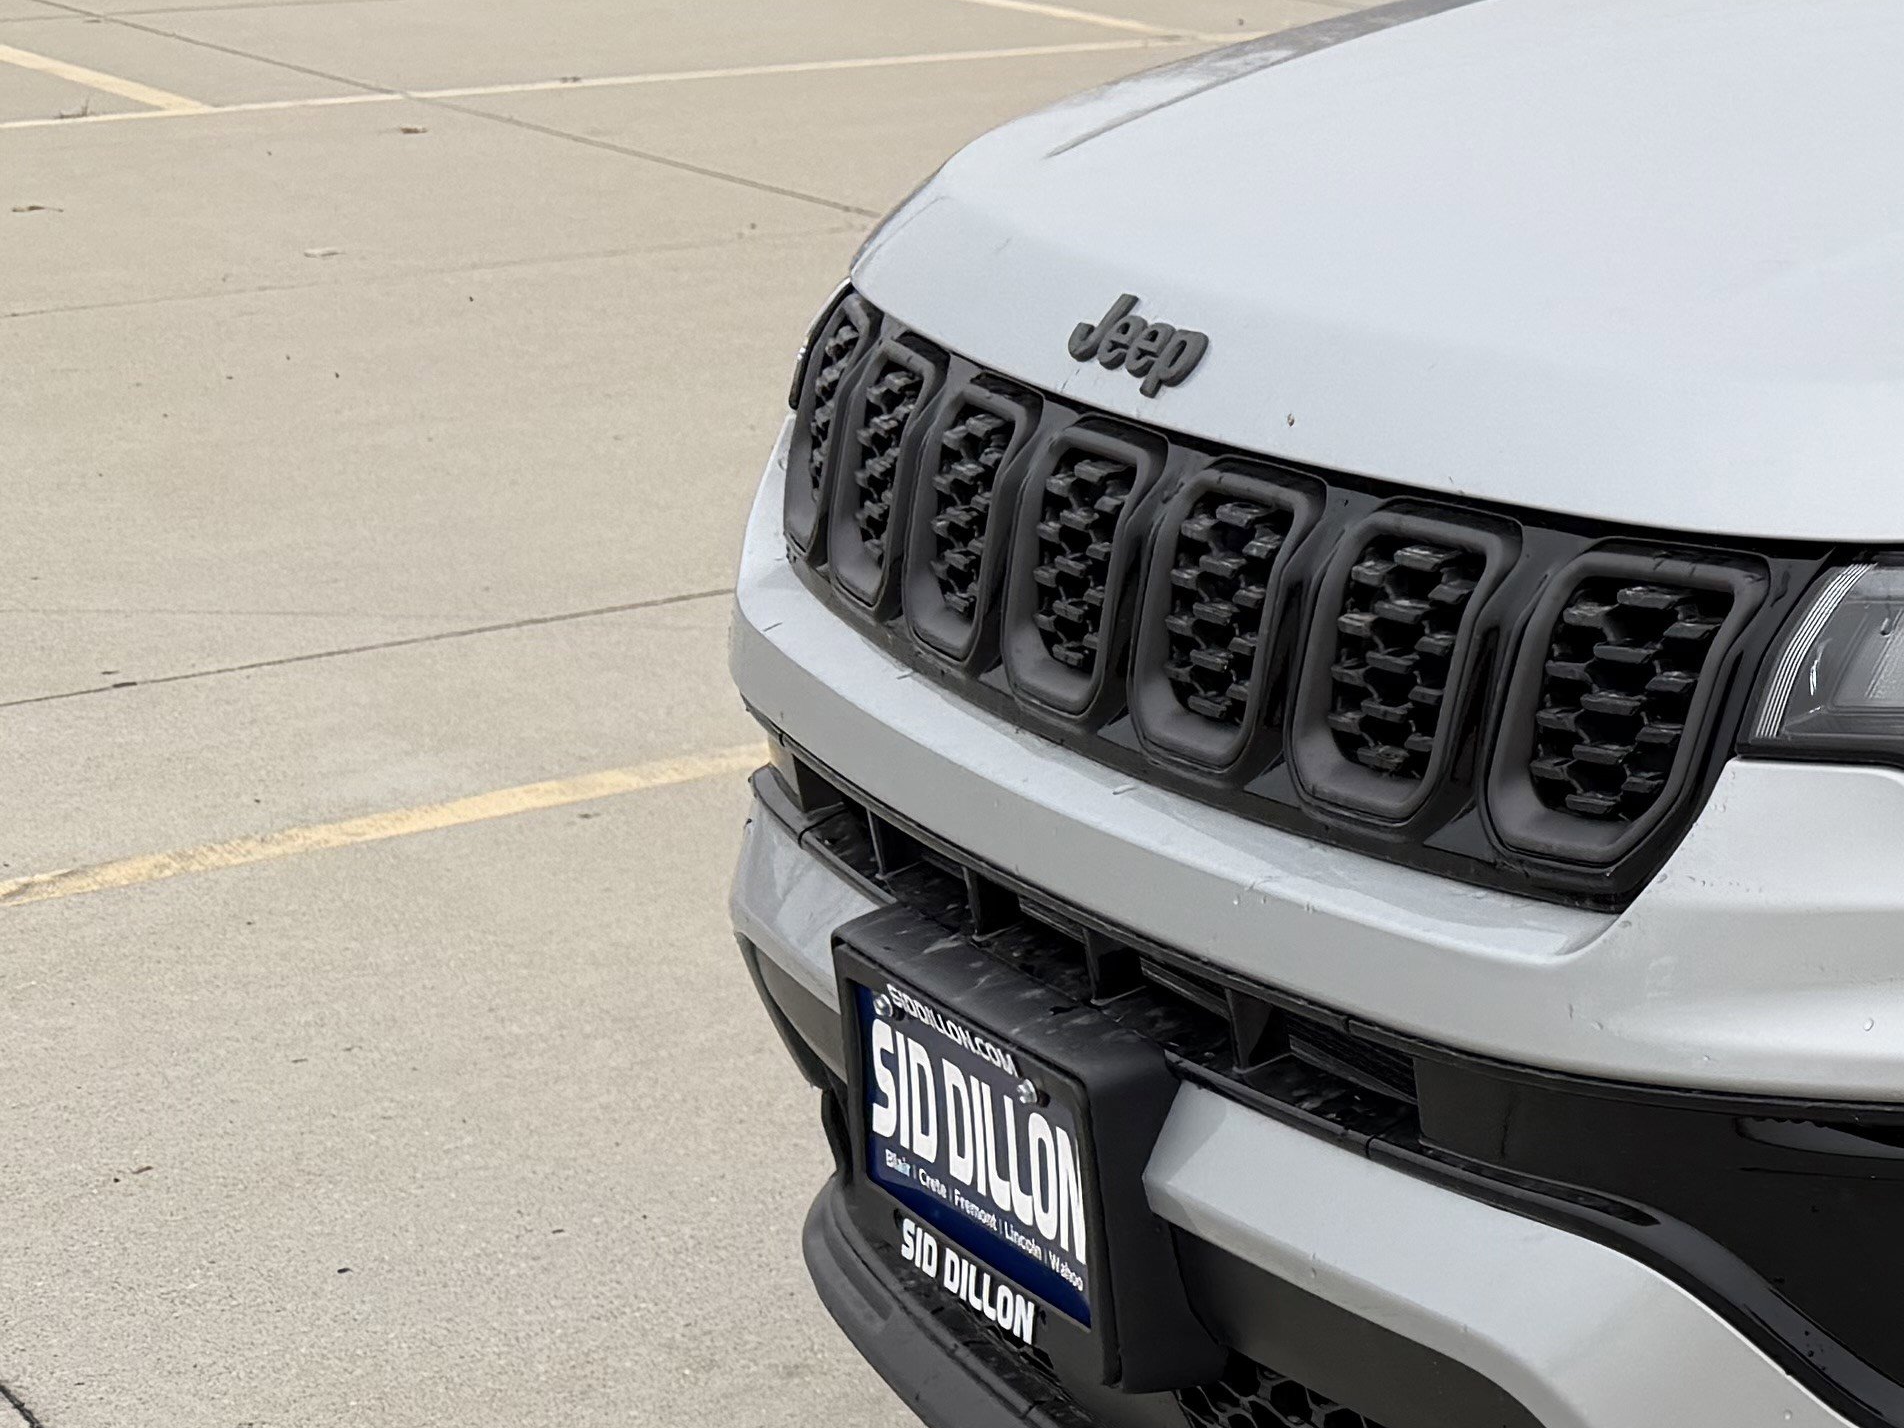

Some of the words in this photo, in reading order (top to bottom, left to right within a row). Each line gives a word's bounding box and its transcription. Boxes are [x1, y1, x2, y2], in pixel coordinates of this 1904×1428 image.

[1068, 293, 1209, 398] Jeep
[886, 983, 1019, 1079] SIDDILLON.COM
[872, 1018, 938, 1164] SID
[942, 1057, 1087, 1266] DILLON
[918, 1168, 947, 1199] Crete
[954, 1188, 998, 1232] Fremont
[1004, 1221, 1042, 1261] Lincoln
[901, 1217, 938, 1279] SID
[943, 1247, 1035, 1345] DILLON
